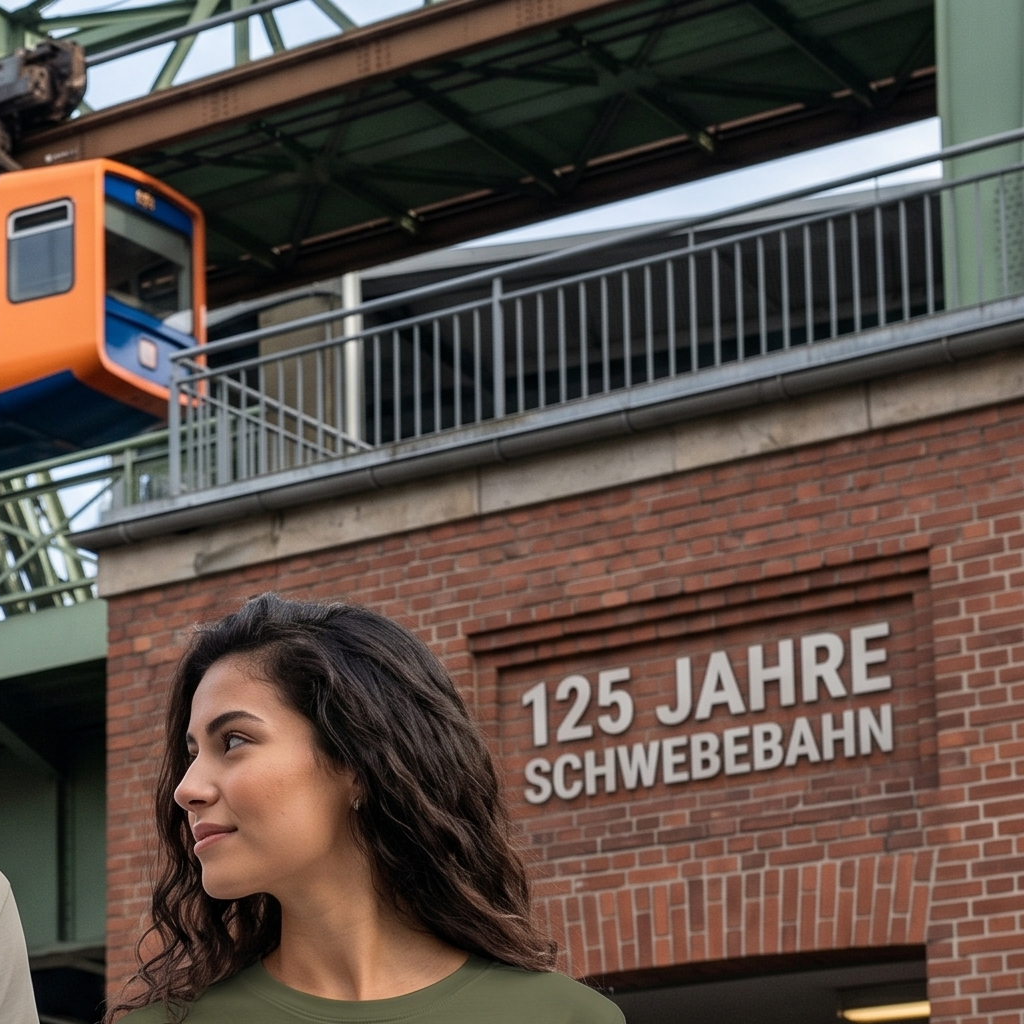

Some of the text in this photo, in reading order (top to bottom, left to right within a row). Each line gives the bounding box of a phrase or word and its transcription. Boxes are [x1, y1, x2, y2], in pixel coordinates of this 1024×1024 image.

[522, 621, 893, 748] 125 JAHRE
[523, 702, 895, 805] SCHWEBEBAHN
